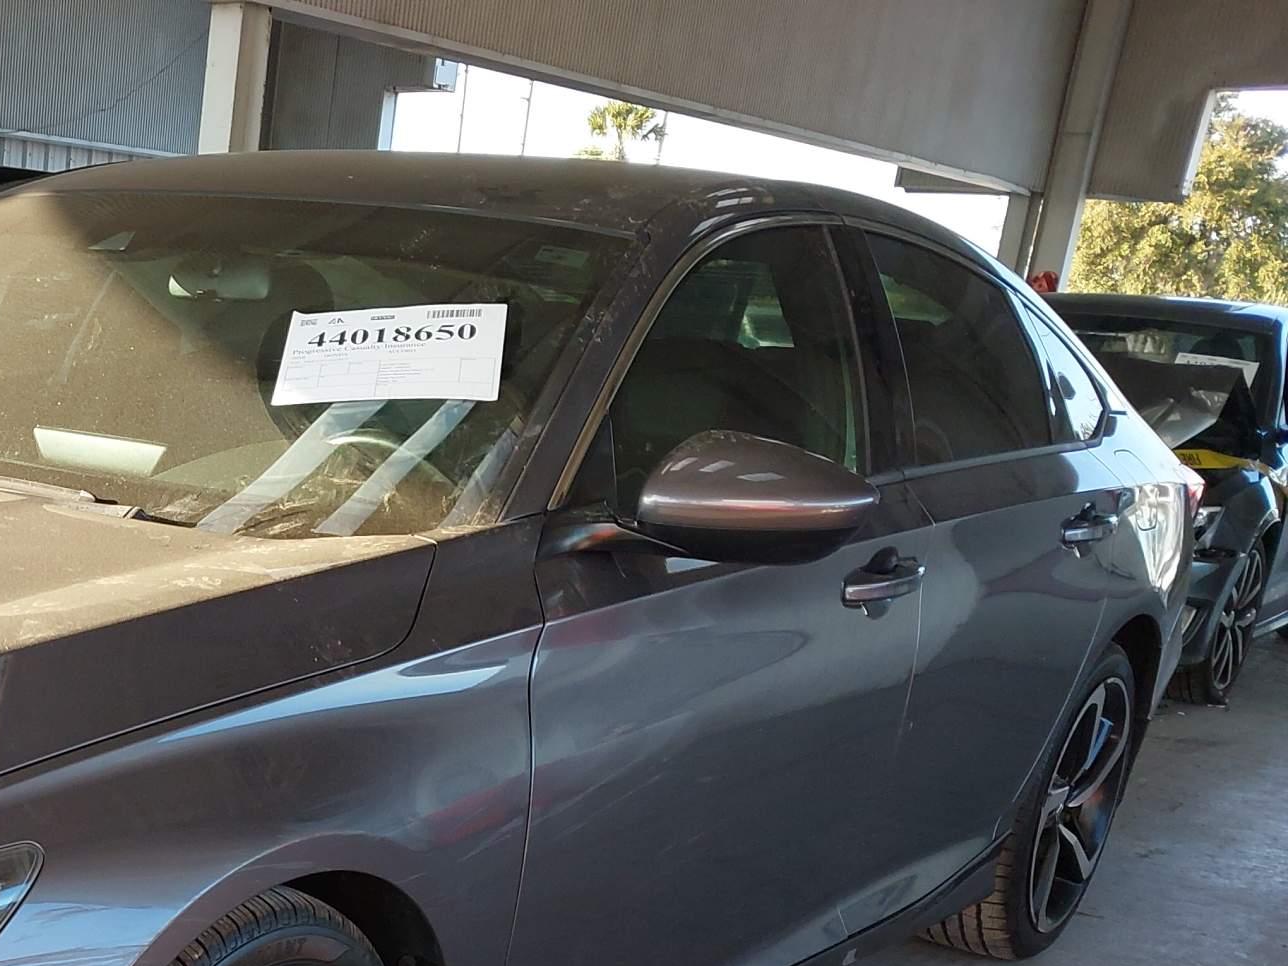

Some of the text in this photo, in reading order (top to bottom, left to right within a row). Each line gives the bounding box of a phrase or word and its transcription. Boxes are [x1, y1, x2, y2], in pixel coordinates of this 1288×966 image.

[307, 323, 478, 348] 44018650
[344, 342, 380, 352] Casualty
[384, 341, 427, 350] Insurance
